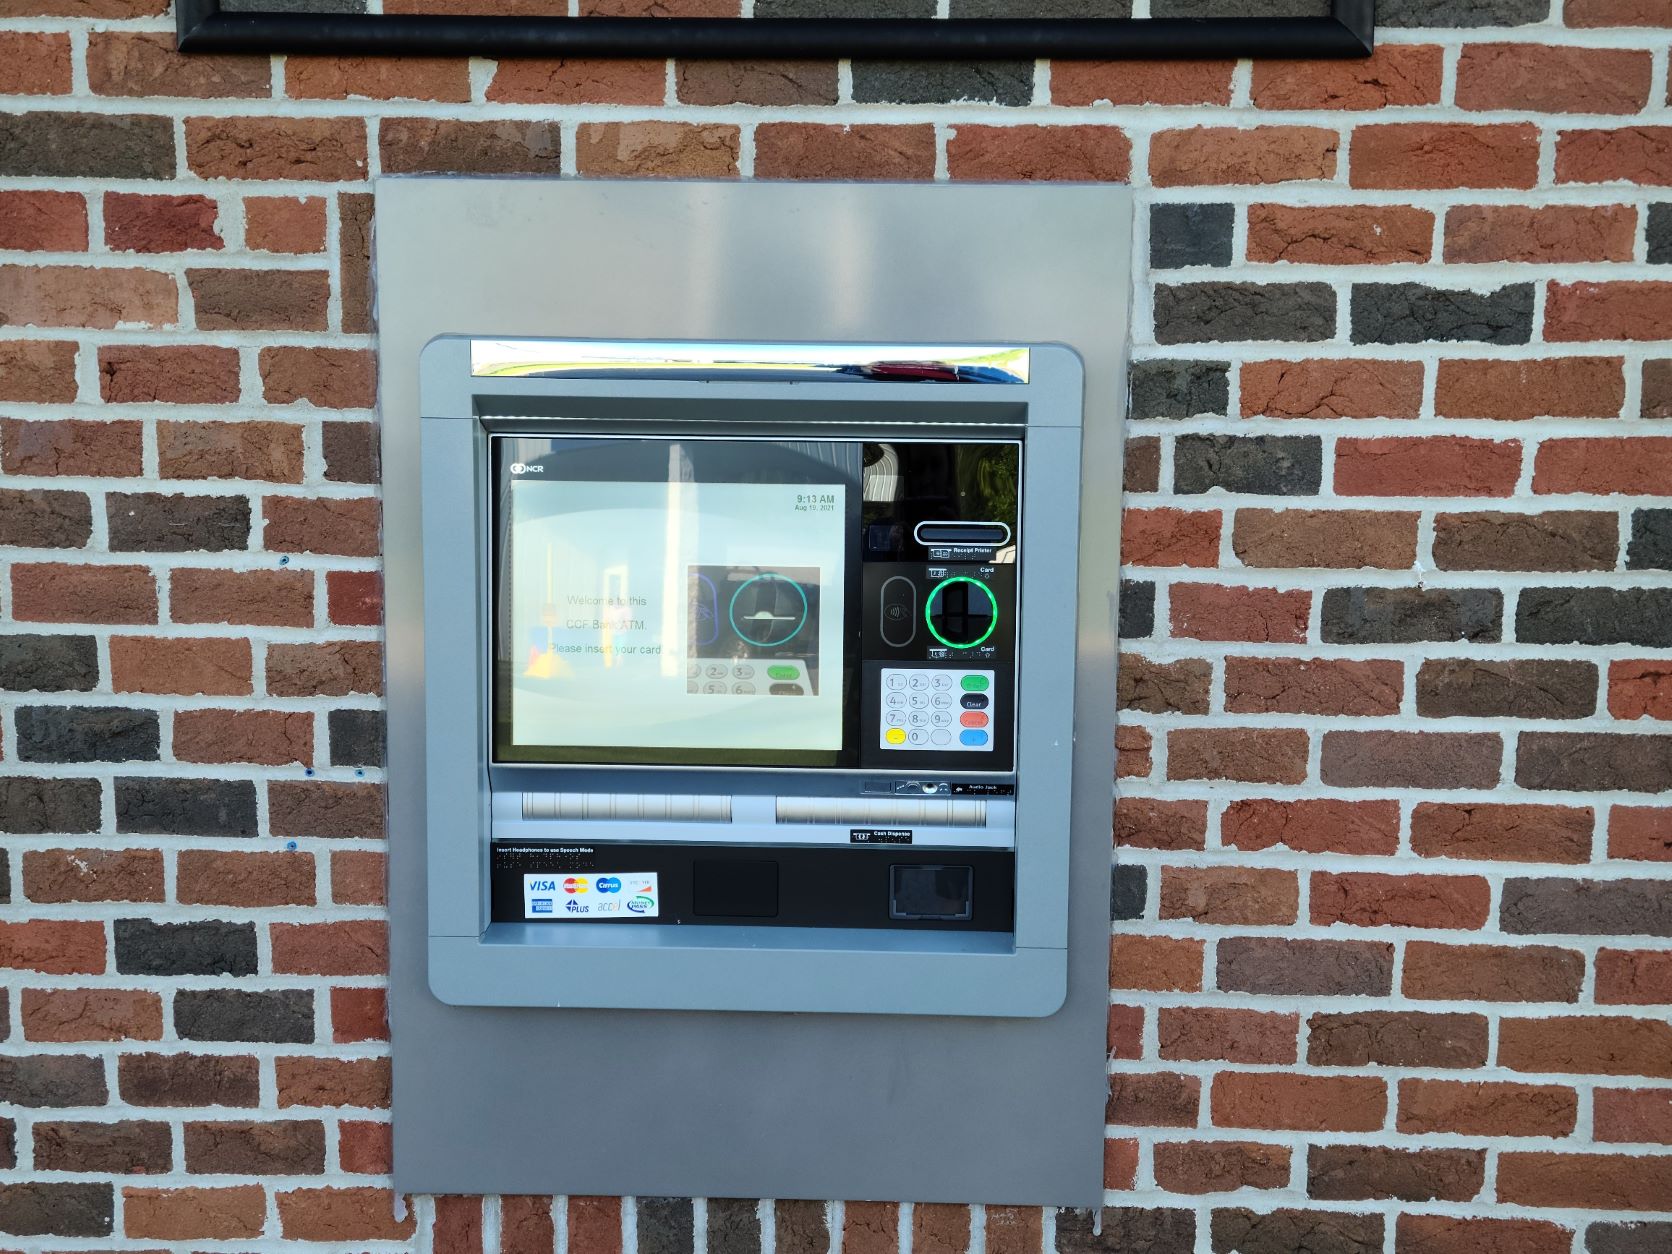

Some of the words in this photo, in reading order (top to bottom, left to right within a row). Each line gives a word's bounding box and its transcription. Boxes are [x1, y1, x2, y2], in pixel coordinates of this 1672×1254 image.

[526, 465, 544, 473] NCR
[797, 494, 817, 503] 9:13
[820, 494, 835, 504] AM
[617, 596, 626, 606] to
[629, 596, 647, 606] this
[549, 642, 582, 654] Please
[615, 645, 637, 657] your
[710, 667, 717, 676] 2
[735, 667, 743, 676] 3
[889, 678, 894, 687] 1
[913, 678, 919, 687] 2
[935, 678, 941, 687] 3
[735, 685, 743, 694] 6
[889, 696, 896, 705] 4
[912, 696, 918, 705] 5
[934, 696, 941, 705] 6
[890, 714, 896, 723] 7
[912, 714, 919, 723] 8
[934, 714, 941, 723] 9
[912, 732, 919, 741] 0
[529, 880, 556, 891] VISA
[572, 905, 590, 913] PLUS
[597, 899, 621, 912] accel
